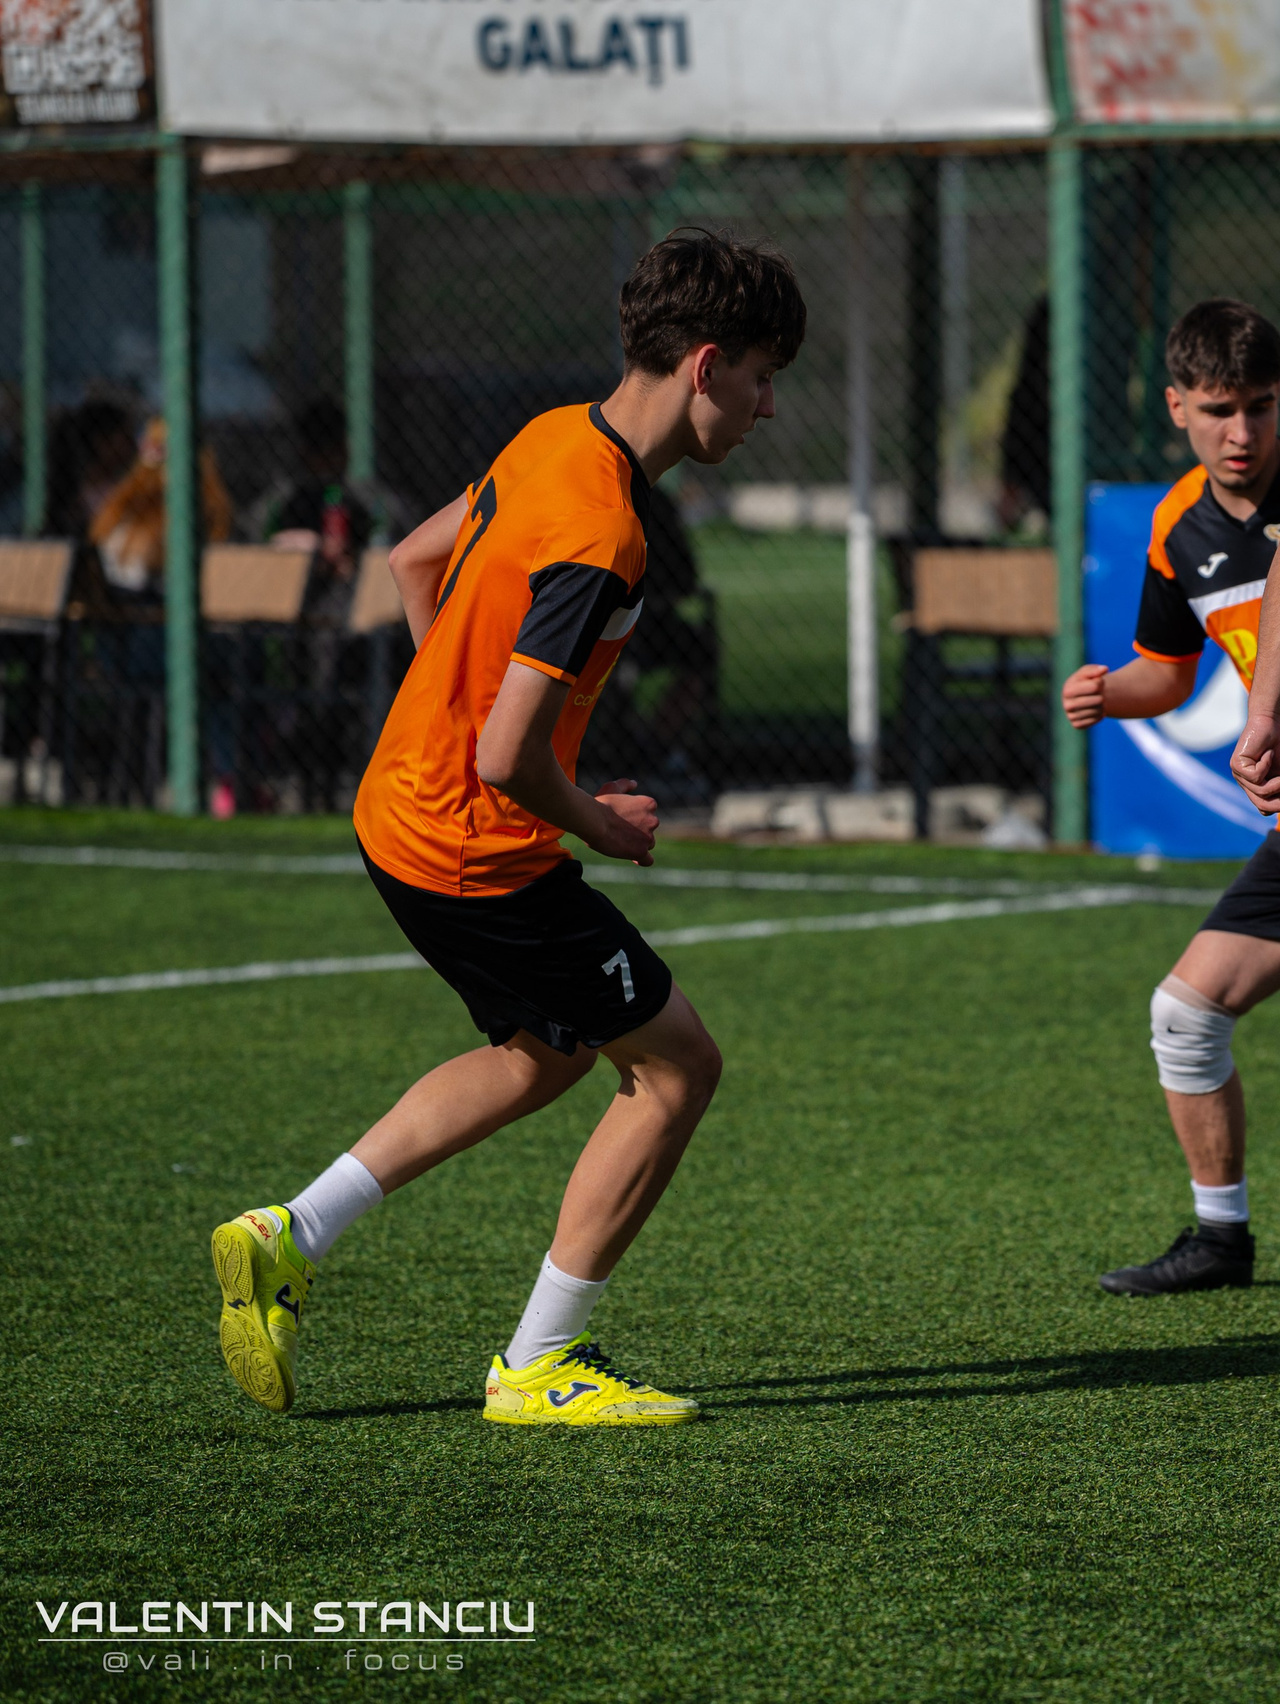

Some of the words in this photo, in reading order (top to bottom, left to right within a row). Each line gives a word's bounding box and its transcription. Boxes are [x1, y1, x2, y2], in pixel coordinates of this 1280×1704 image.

[431, 475, 498, 630] 7
[601, 948, 635, 1003] 7
[241, 1213, 271, 1241] FLEX
[486, 1386, 500, 1396] EX
